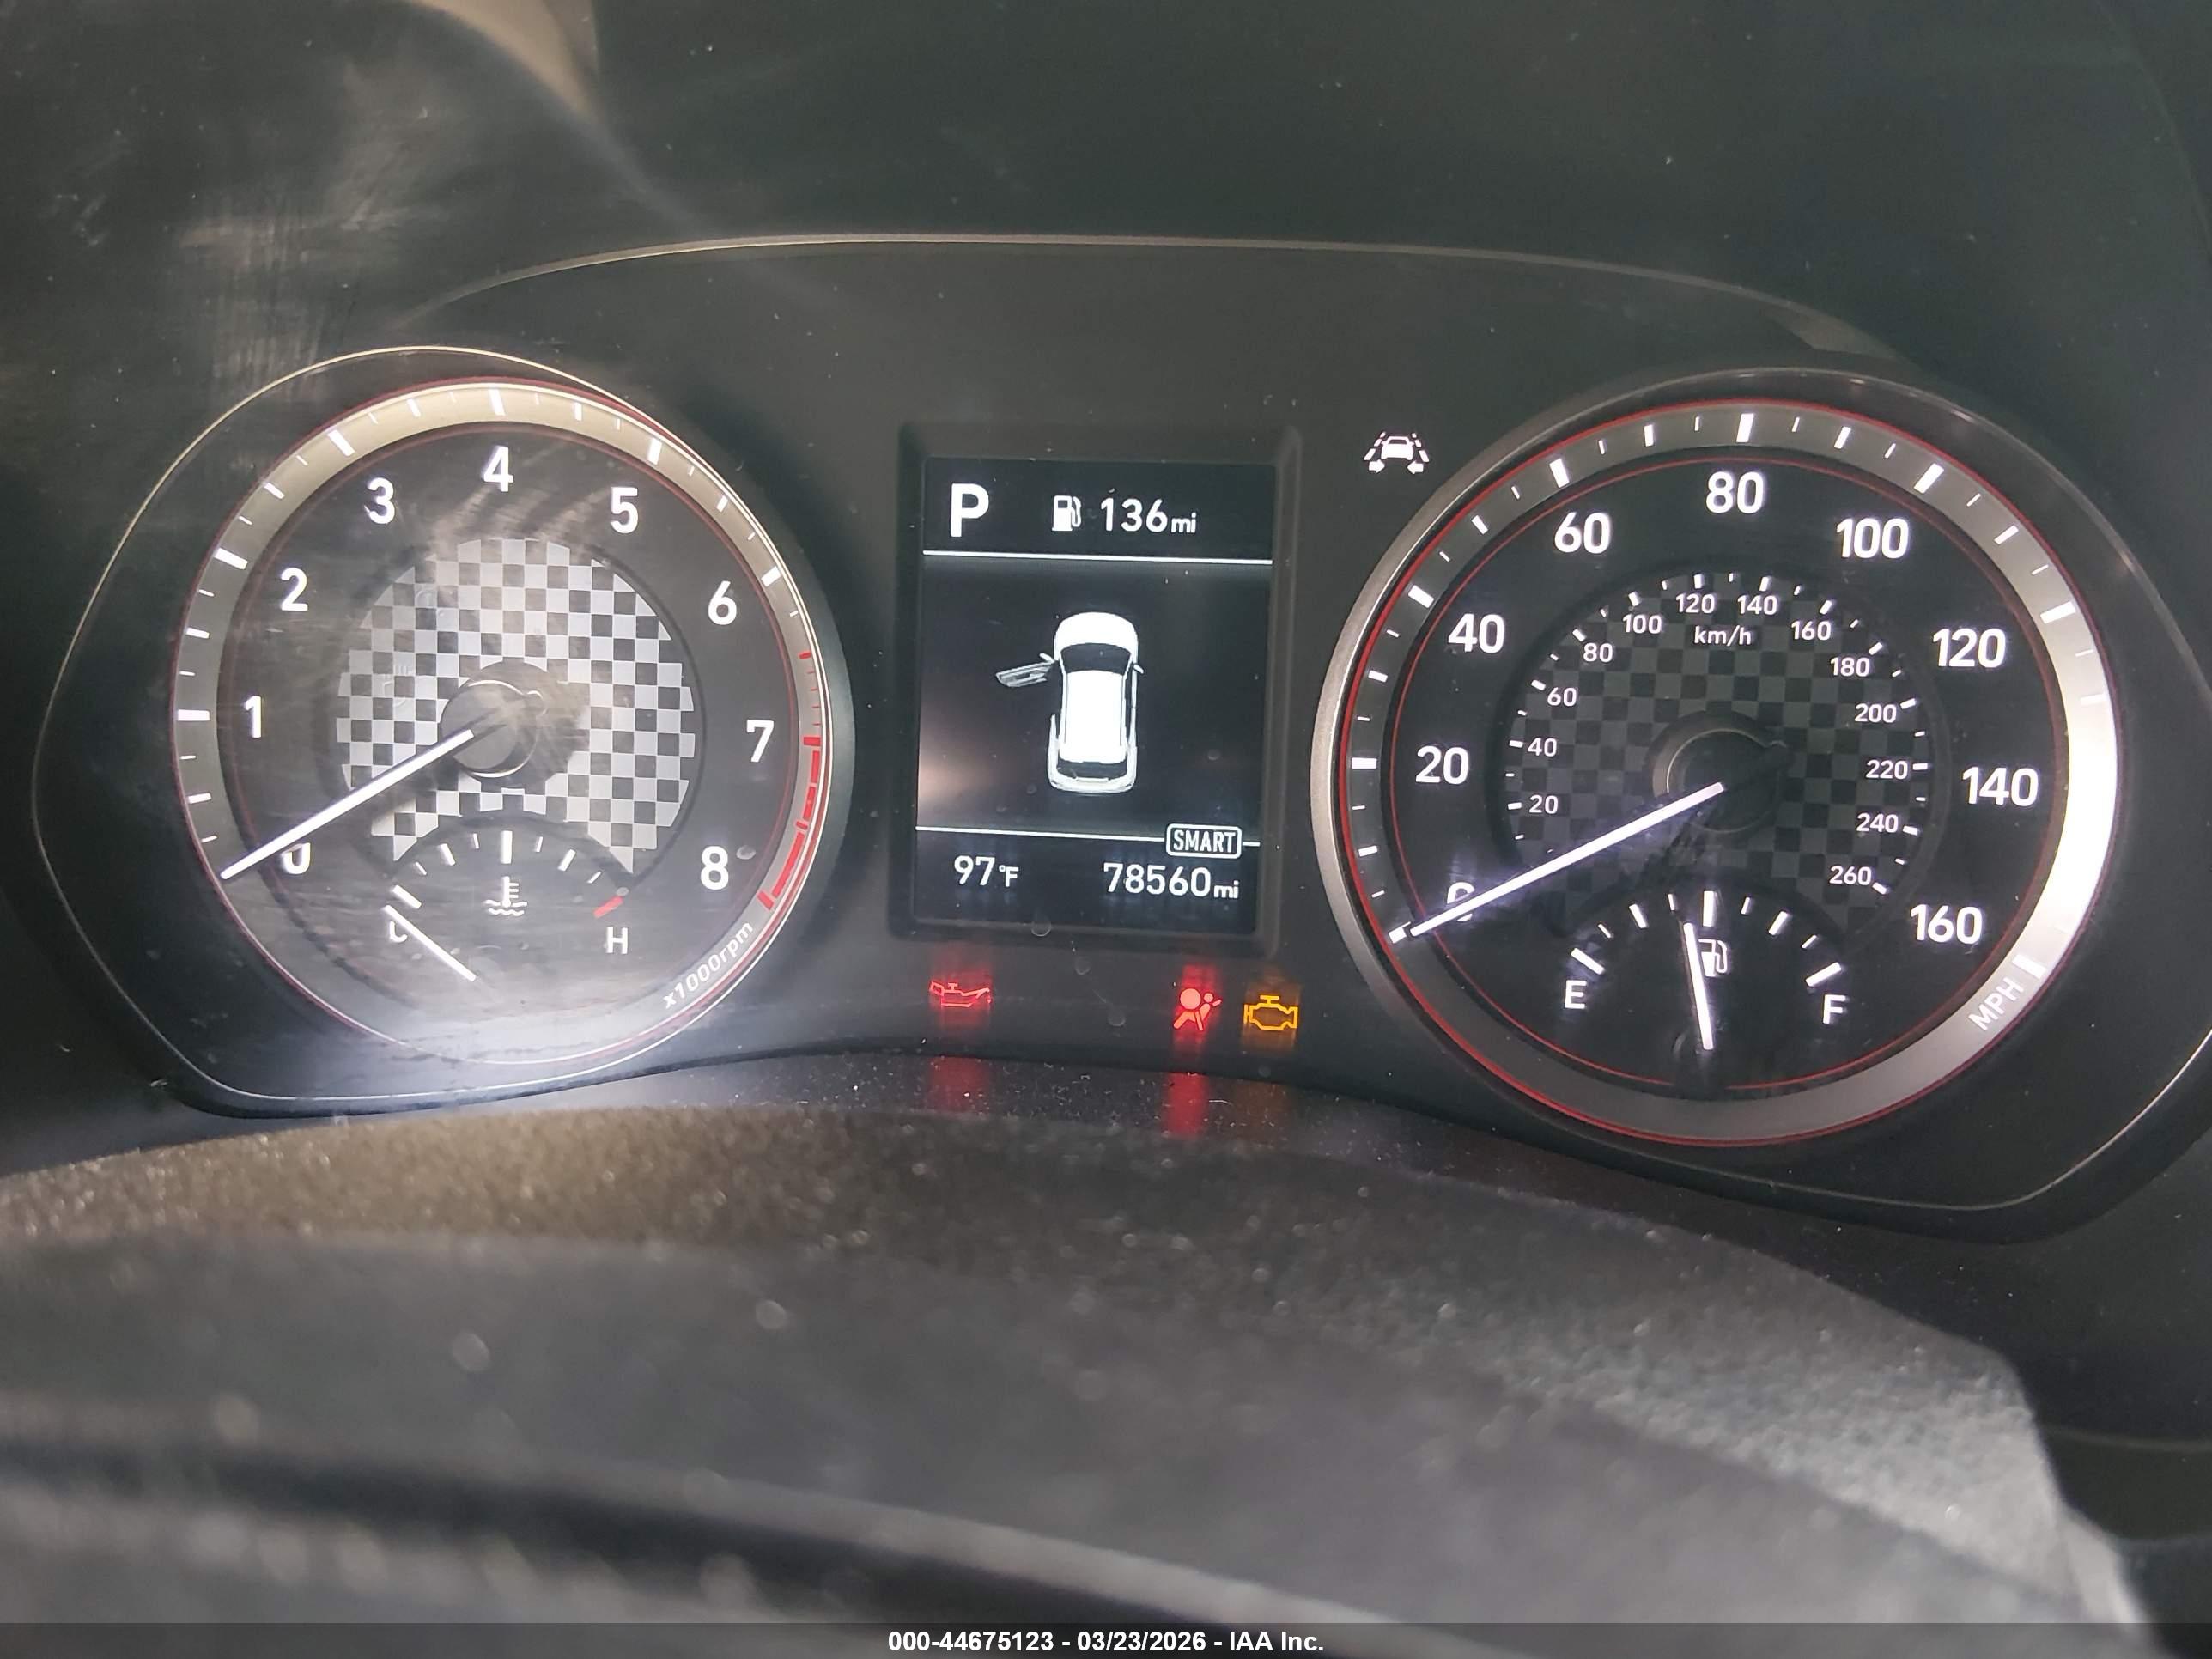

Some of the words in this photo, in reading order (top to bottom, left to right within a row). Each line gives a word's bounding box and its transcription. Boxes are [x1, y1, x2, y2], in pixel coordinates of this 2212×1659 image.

[483, 446, 514, 491] 4
[365, 477, 394, 524] 3
[1706, 471, 1765, 513] 80
[611, 487, 638, 533] 5
[950, 483, 989, 538] P
[1555, 513, 1610, 553] 60
[1837, 518, 1909, 558] 100
[281, 568, 307, 611] 2
[708, 580, 737, 625] 6
[1676, 592, 1715, 613] 120
[1738, 595, 1778, 615] 140
[1449, 614, 1504, 653] 40
[1623, 614, 1662, 634] 100
[1695, 625, 1751, 646] km/h
[1792, 621, 1831, 640] 160
[1583, 643, 1613, 662] 80
[1934, 629, 2006, 667] 120
[1831, 658, 1869, 677] 180
[1547, 687, 1577, 706] 60
[1855, 703, 1896, 722] 200
[245, 696, 261, 738] 1
[747, 720, 774, 762] 7
[1528, 738, 1557, 757] 40
[1416, 748, 1468, 784] 20
[1866, 760, 1908, 779] 220
[1963, 767, 2039, 806] 140
[1529, 795, 1558, 813] 20
[1856, 813, 1898, 832] 240
[1173, 830, 1236, 854] SMART
[701, 846, 728, 890] 8
[1830, 866, 1871, 884] 260
[605, 927, 628, 954] H
[1911, 904, 1983, 944] 160
[1565, 980, 1587, 1009] E
[1823, 994, 1846, 1024] F
[1968, 977, 2024, 1031] MPH
